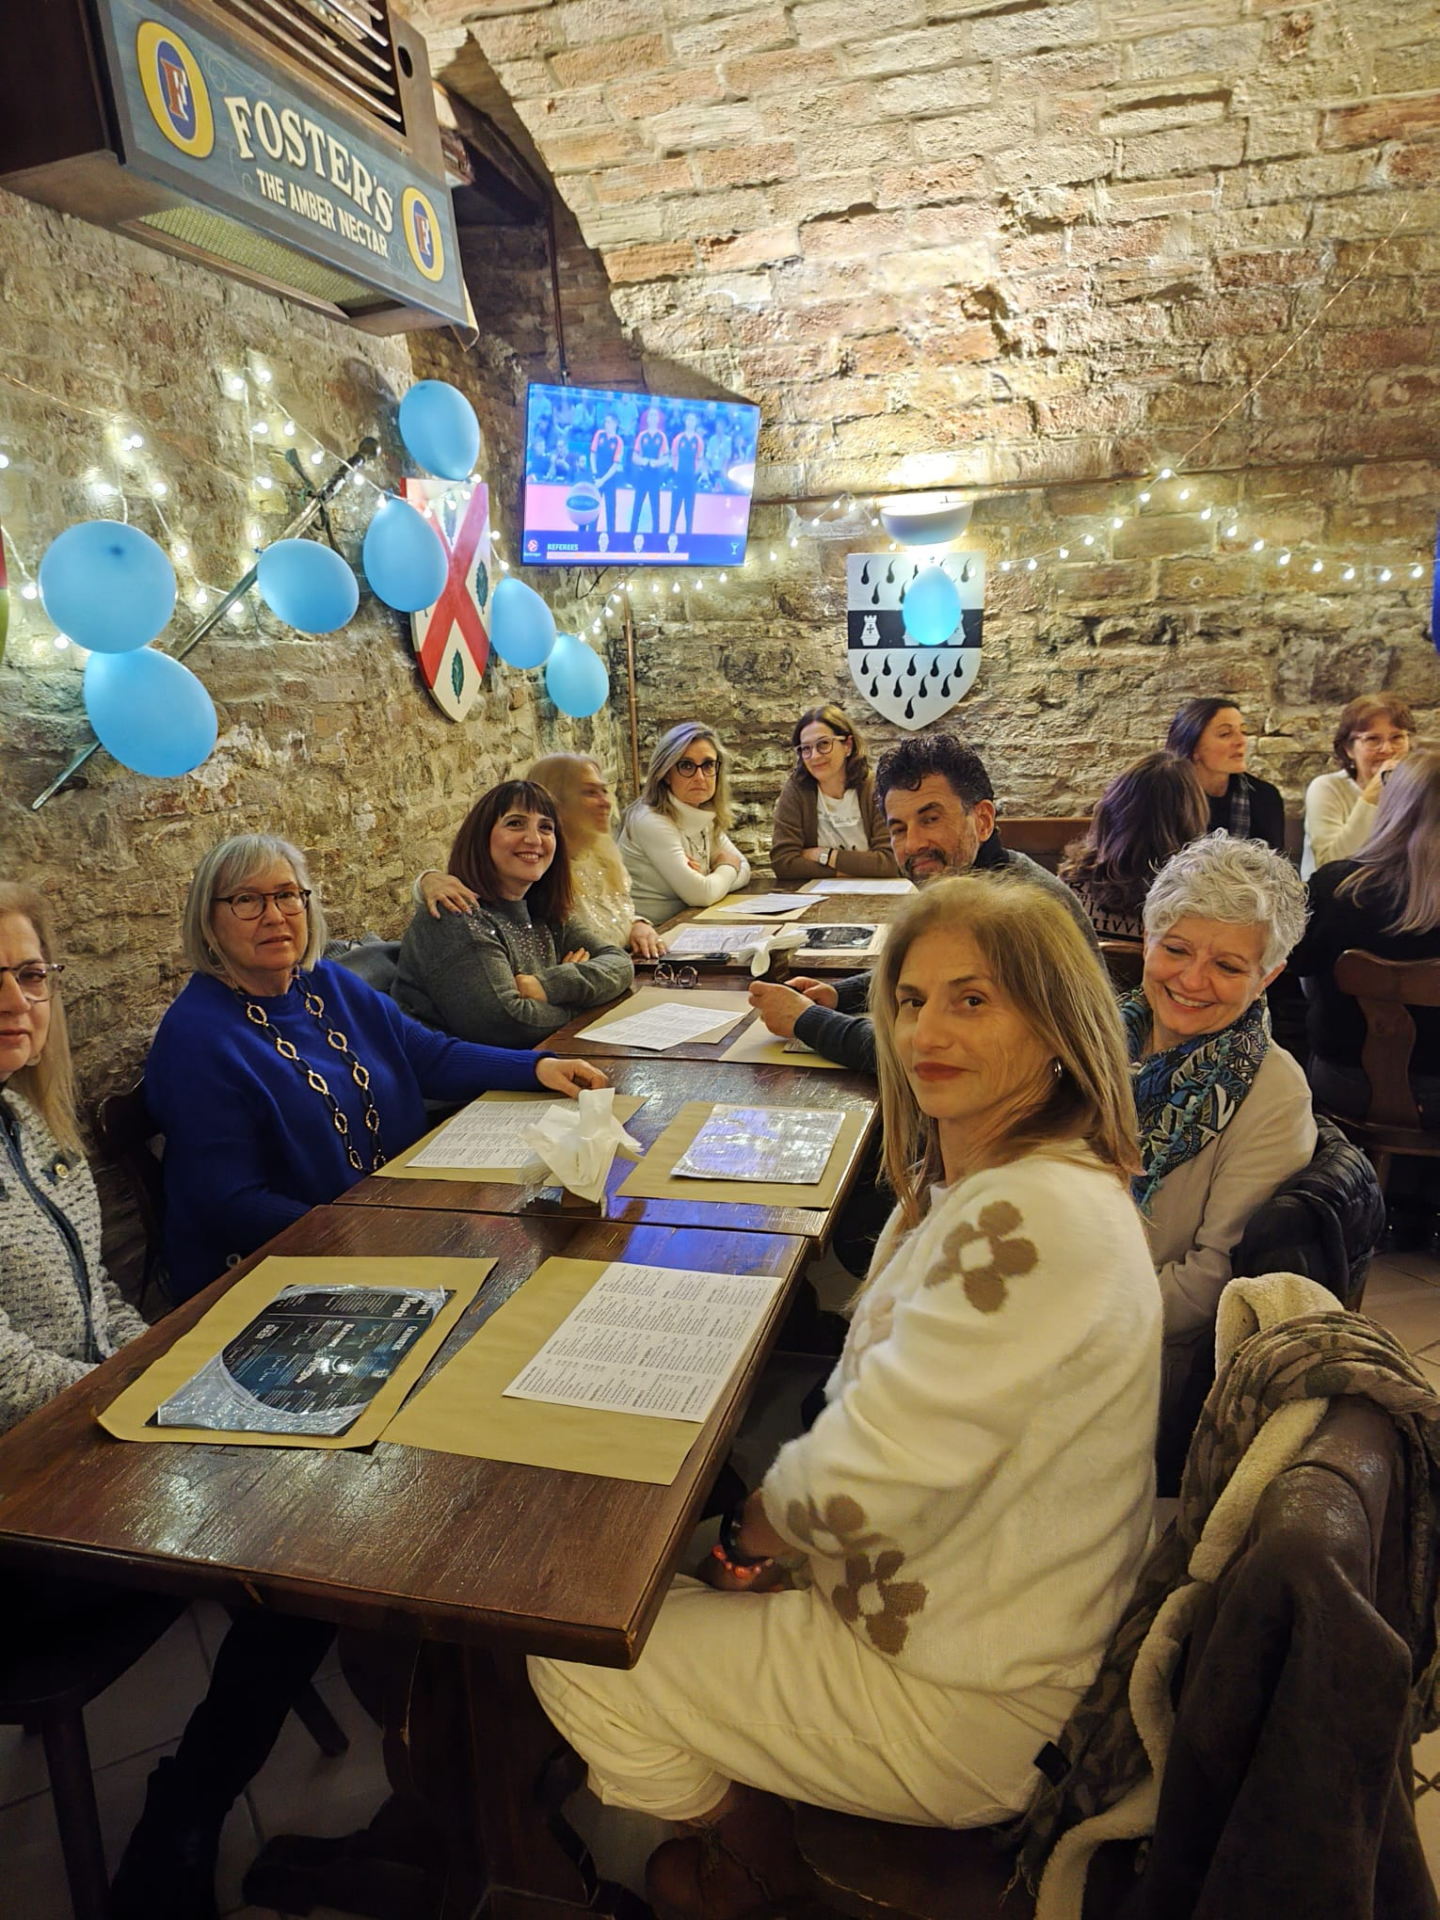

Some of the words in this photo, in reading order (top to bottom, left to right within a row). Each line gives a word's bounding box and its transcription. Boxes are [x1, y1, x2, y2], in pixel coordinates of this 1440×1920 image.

[160, 57, 189, 121] F
[224, 97, 393, 233] FOSTER'S
[256, 167, 286, 206] THE
[289, 182, 336, 232] AMBER
[337, 206, 388, 258] NECTAR
[414, 211, 431, 256] F
